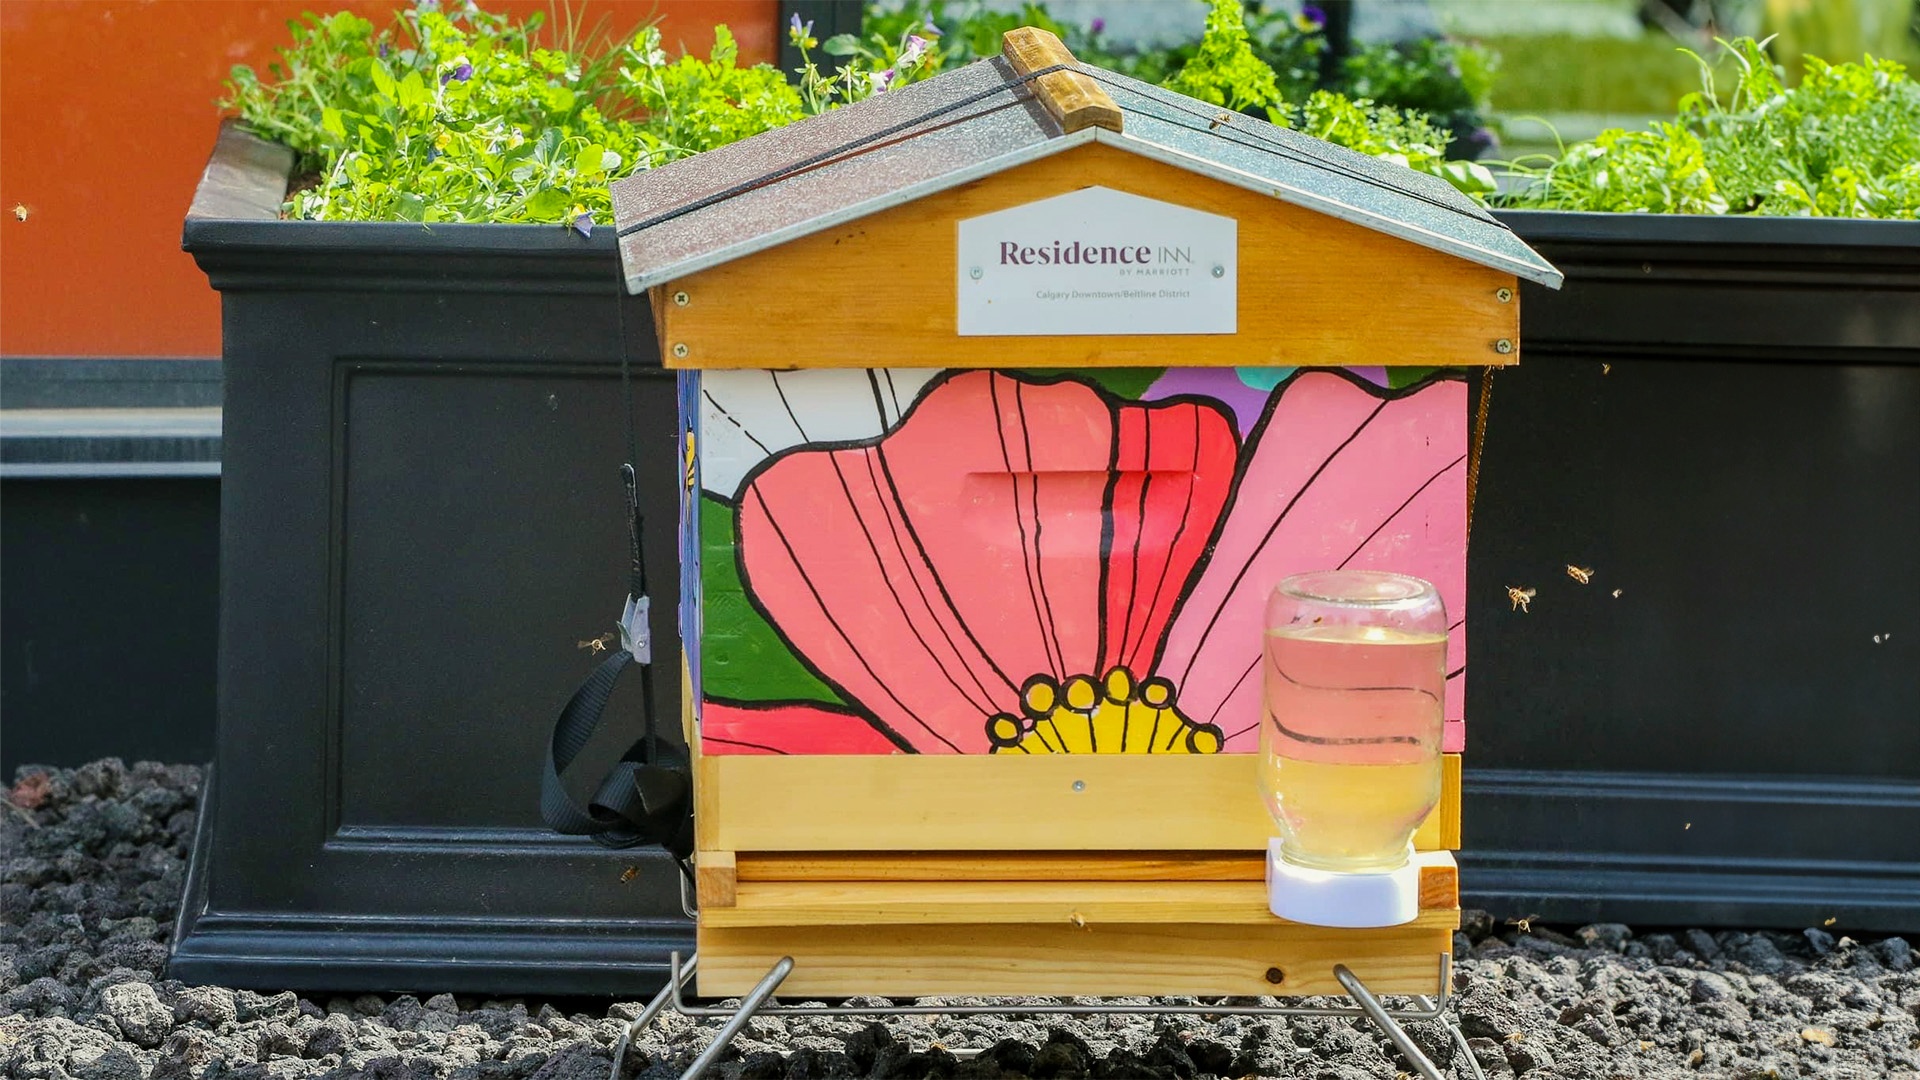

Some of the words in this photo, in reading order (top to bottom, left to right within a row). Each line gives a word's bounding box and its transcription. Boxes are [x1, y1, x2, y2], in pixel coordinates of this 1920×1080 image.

[1000, 240, 1151, 265] Residence
[1119, 268, 1132, 276] BY
[1136, 268, 1190, 276] MARRIOTT
[1036, 289, 1069, 300] Calgary
[1071, 289, 1156, 299] Downtown/Beltline
[1158, 289, 1190, 299] District
